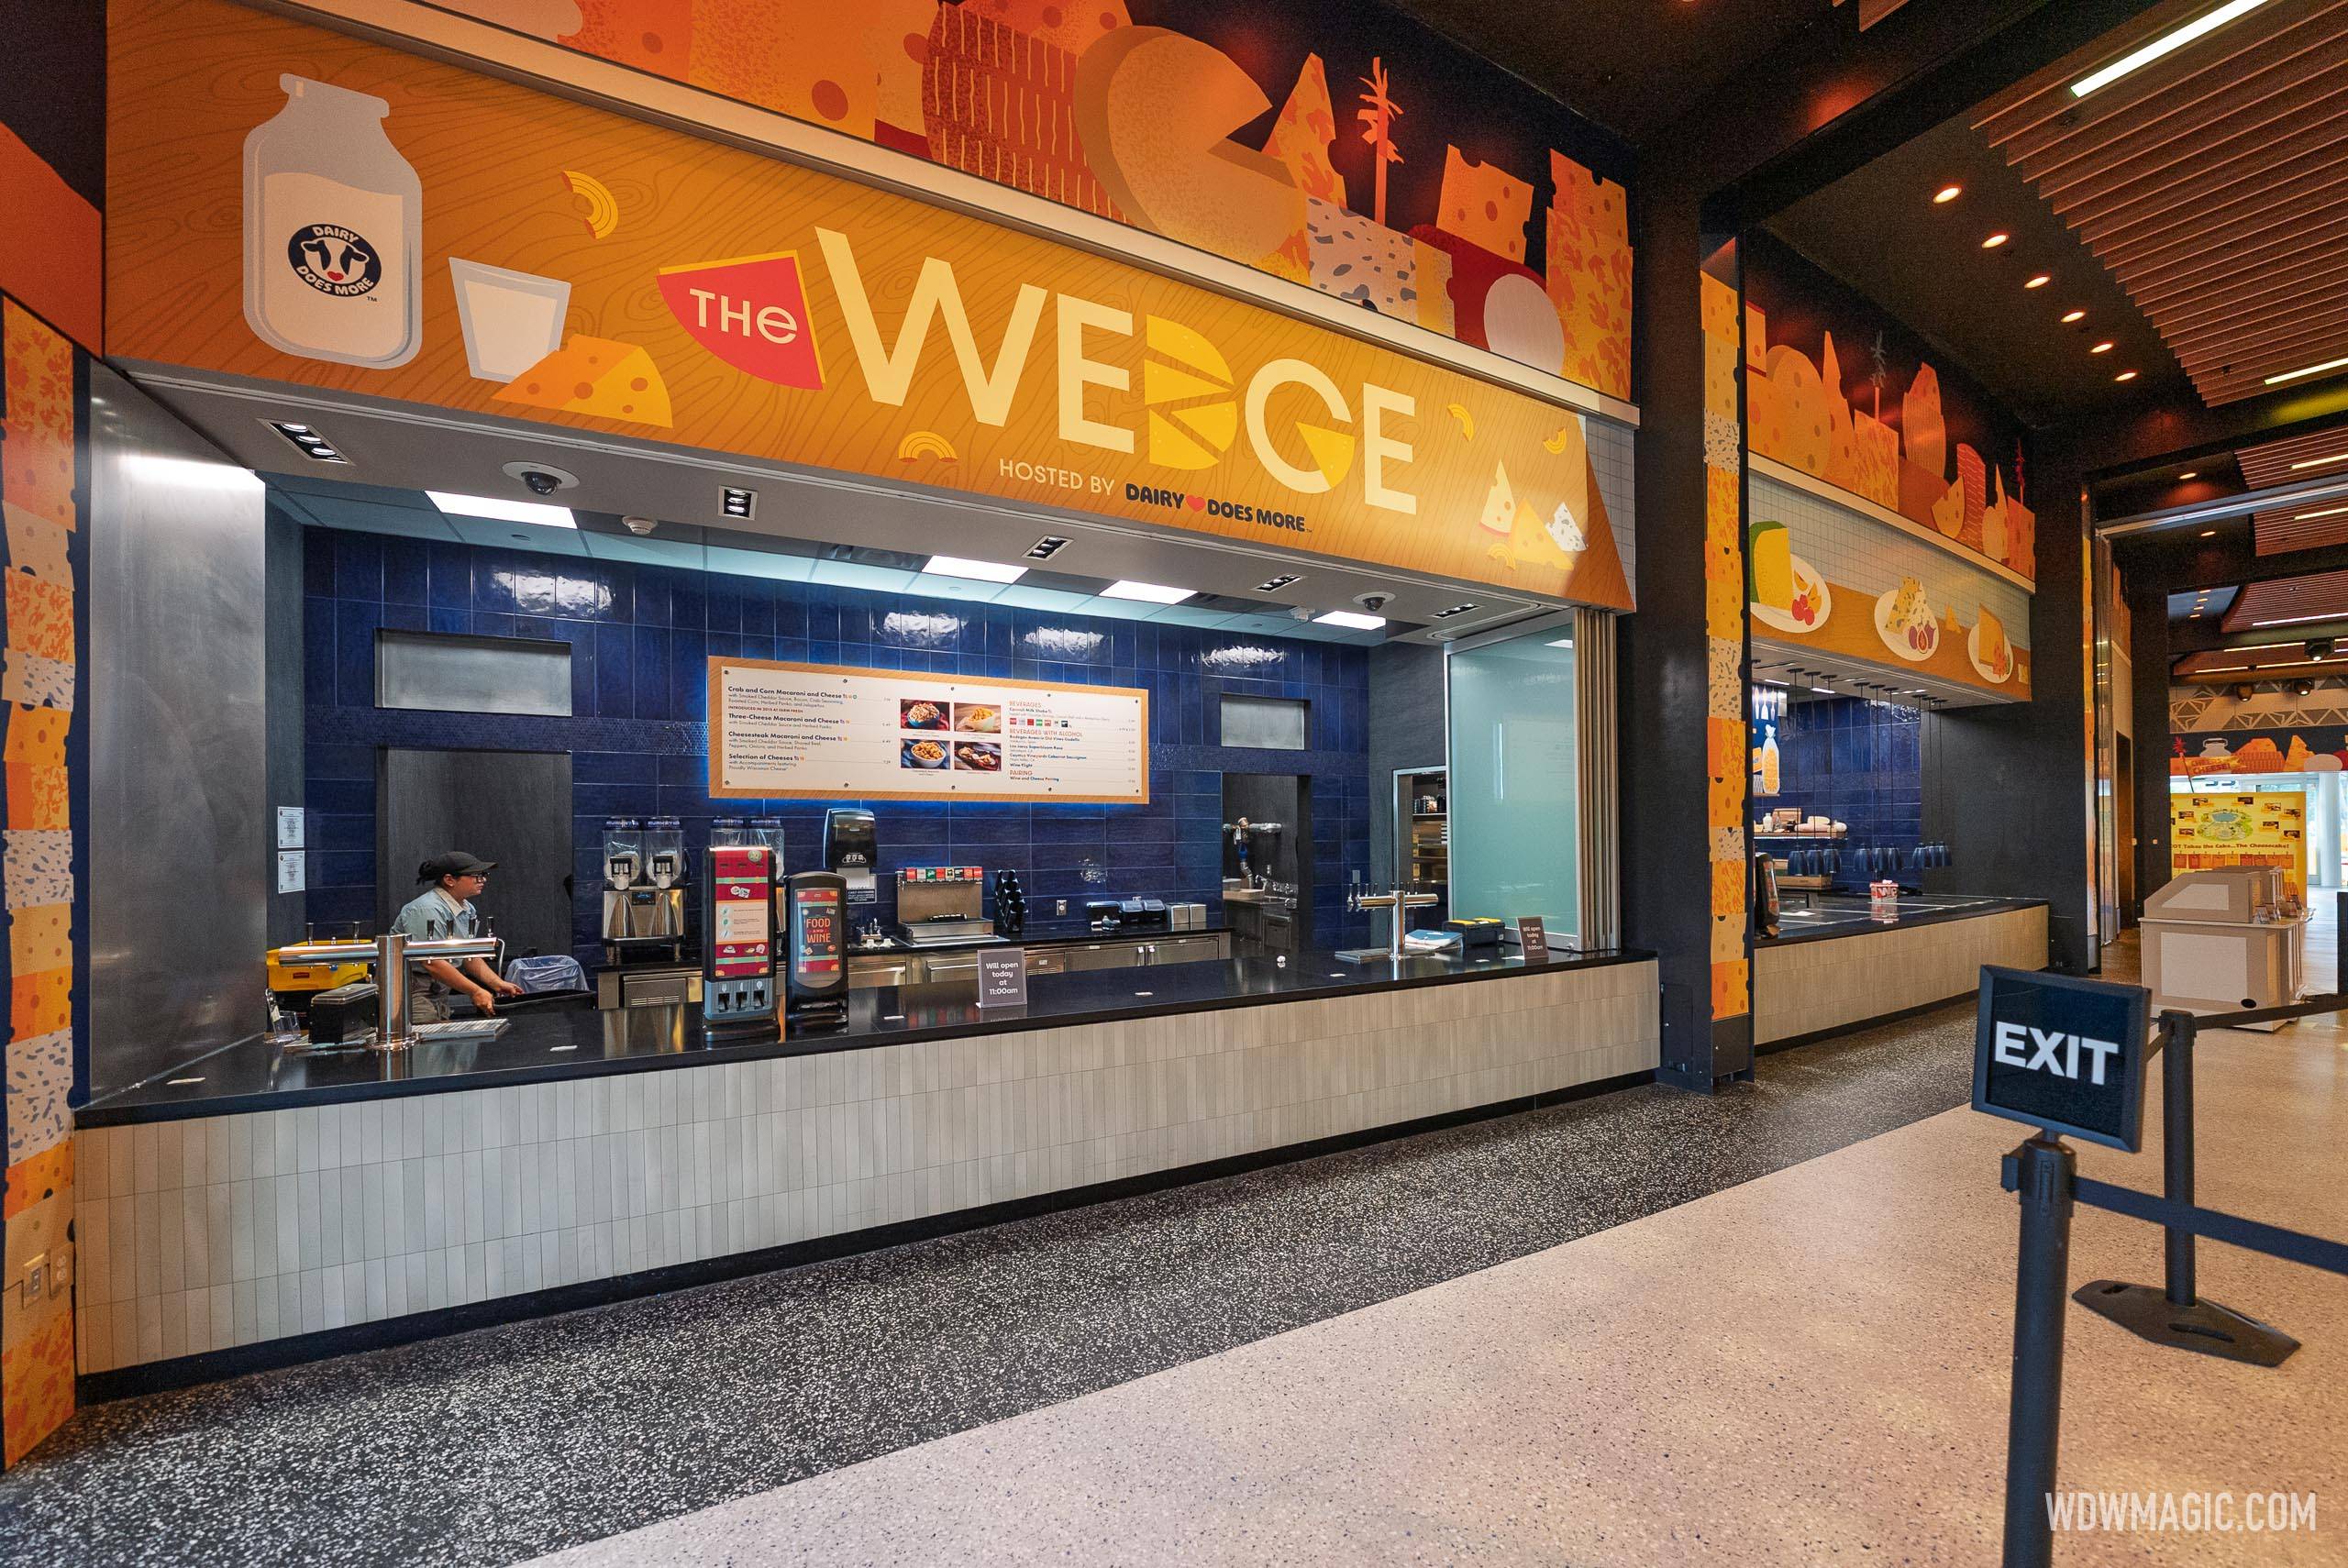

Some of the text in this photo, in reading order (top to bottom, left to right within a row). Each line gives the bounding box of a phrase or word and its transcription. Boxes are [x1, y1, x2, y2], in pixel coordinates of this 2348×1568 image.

[312, 226, 360, 242] DAIRY
[296, 266, 374, 295] DOES MORE
[814, 226, 1417, 515] WEDGE
[999, 458, 1306, 532] HOSTED BY DAIRY DOES MORE
[806, 918, 831, 929] FOOD
[807, 933, 831, 944] WINE
[992, 970, 1013, 978] today
[1001, 962, 1018, 970] open
[1995, 1021, 2119, 1086] EXIT
